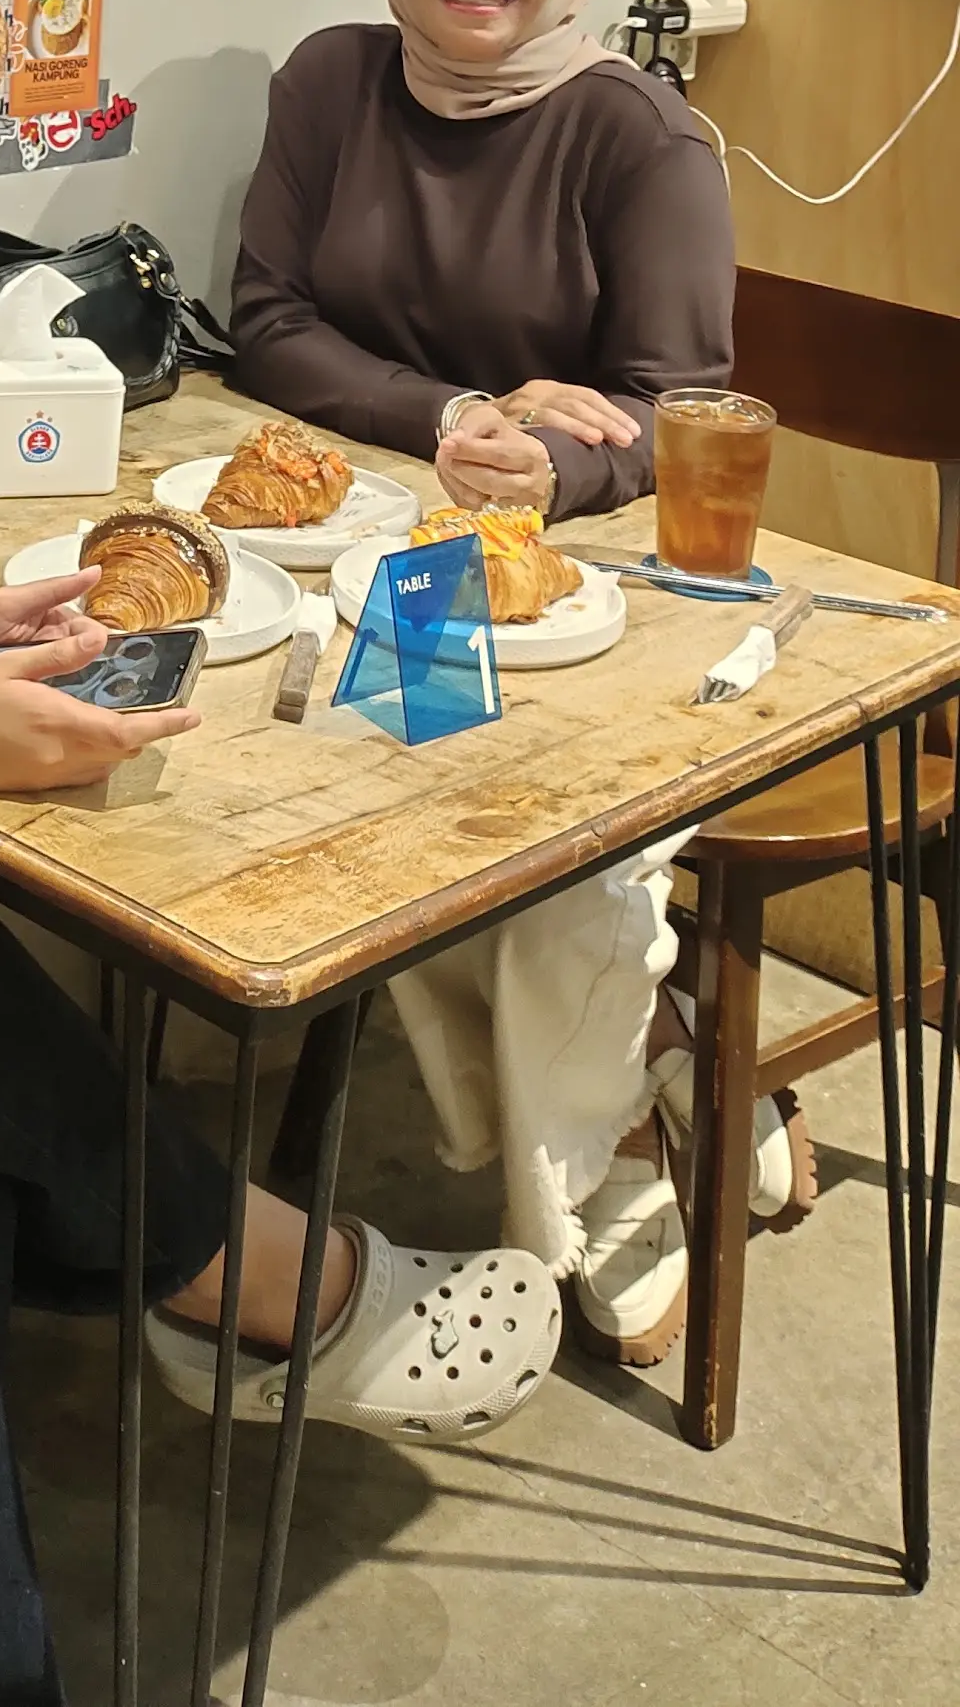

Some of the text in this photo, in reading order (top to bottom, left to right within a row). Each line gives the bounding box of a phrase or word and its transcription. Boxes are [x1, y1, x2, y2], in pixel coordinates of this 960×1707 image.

[24, 58, 88, 74] NASI GORENG
[32, 69, 80, 83] KAMPUNG
[396, 572, 432, 595] TABLE
[467, 625, 496, 714] 1
